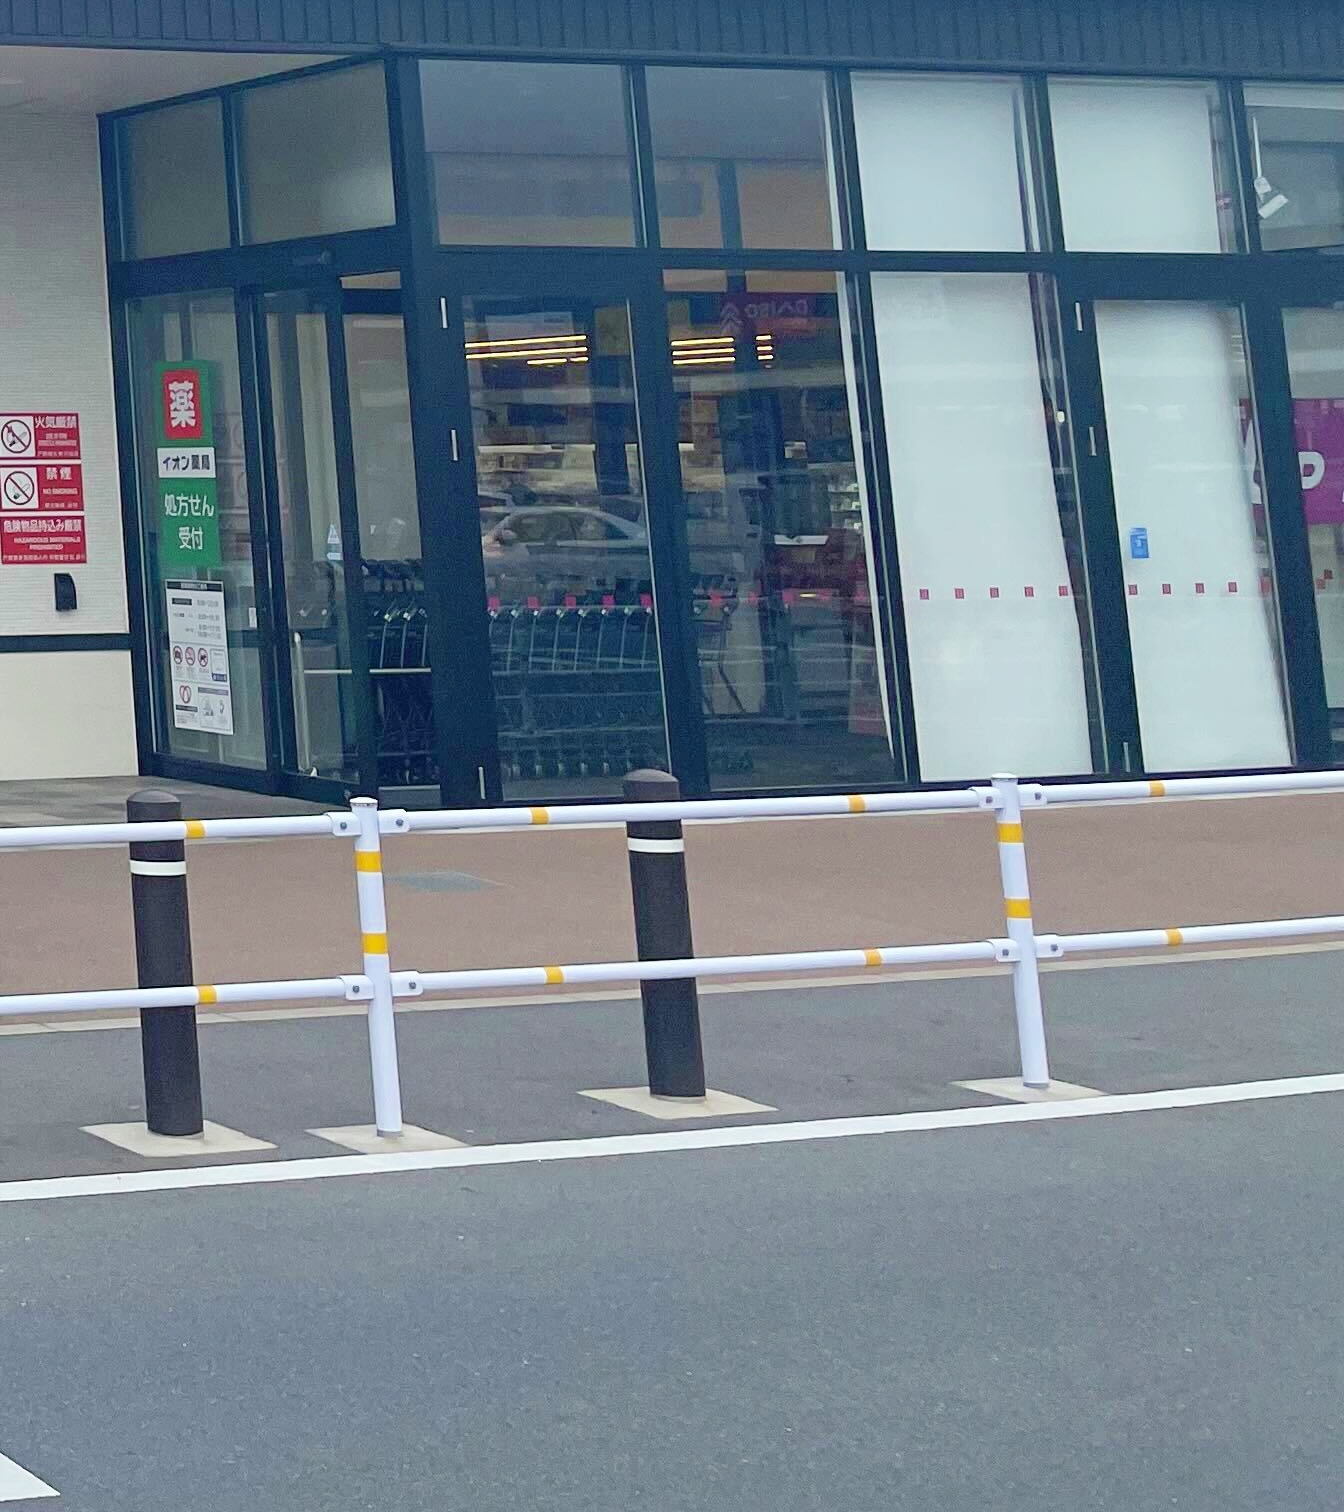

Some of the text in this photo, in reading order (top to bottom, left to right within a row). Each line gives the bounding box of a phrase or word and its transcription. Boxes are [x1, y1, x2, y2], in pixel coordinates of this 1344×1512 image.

[168, 380, 197, 428] 薬
[164, 493, 215, 517] 処方せん
[178, 526, 204, 550] 受付
